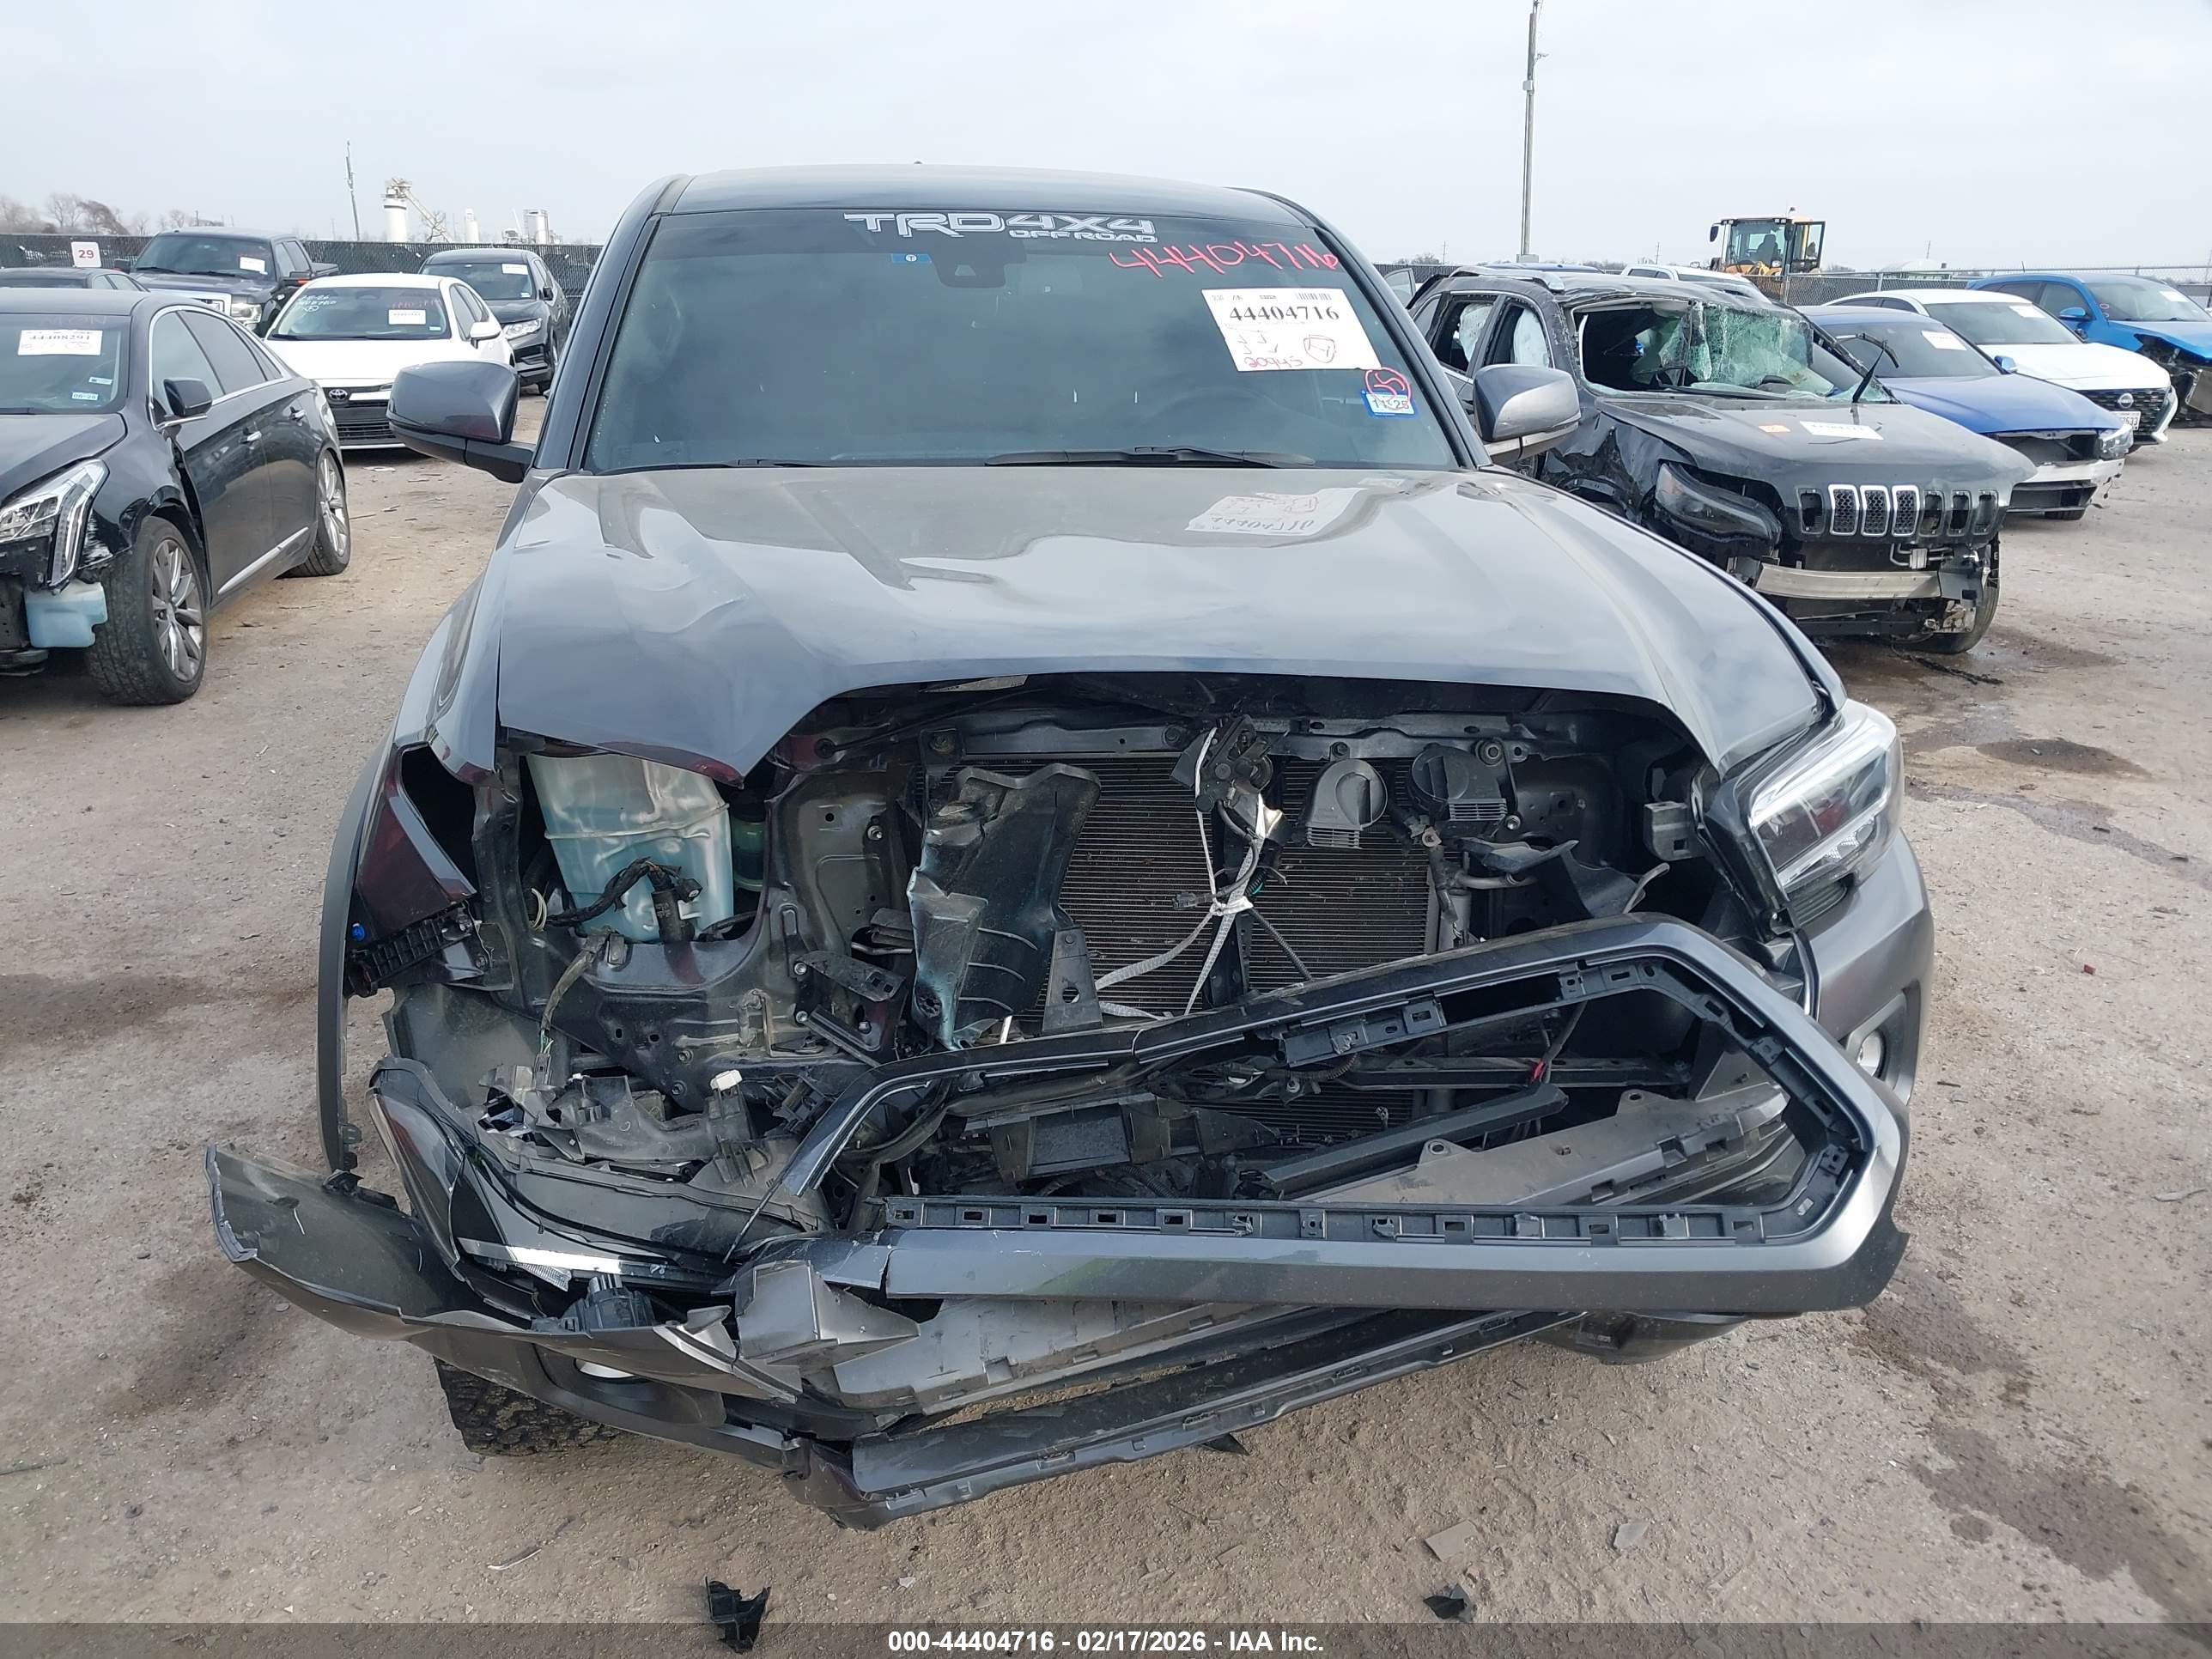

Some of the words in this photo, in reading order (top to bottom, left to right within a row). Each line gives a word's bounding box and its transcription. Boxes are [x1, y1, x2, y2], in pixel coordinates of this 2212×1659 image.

[1008, 229, 1071, 240] OFF
[1073, 231, 1158, 243] ROAD
[78, 249, 94, 258] 29
[1109, 240, 1339, 277] 44404716
[1229, 306, 1340, 321] 44404716
